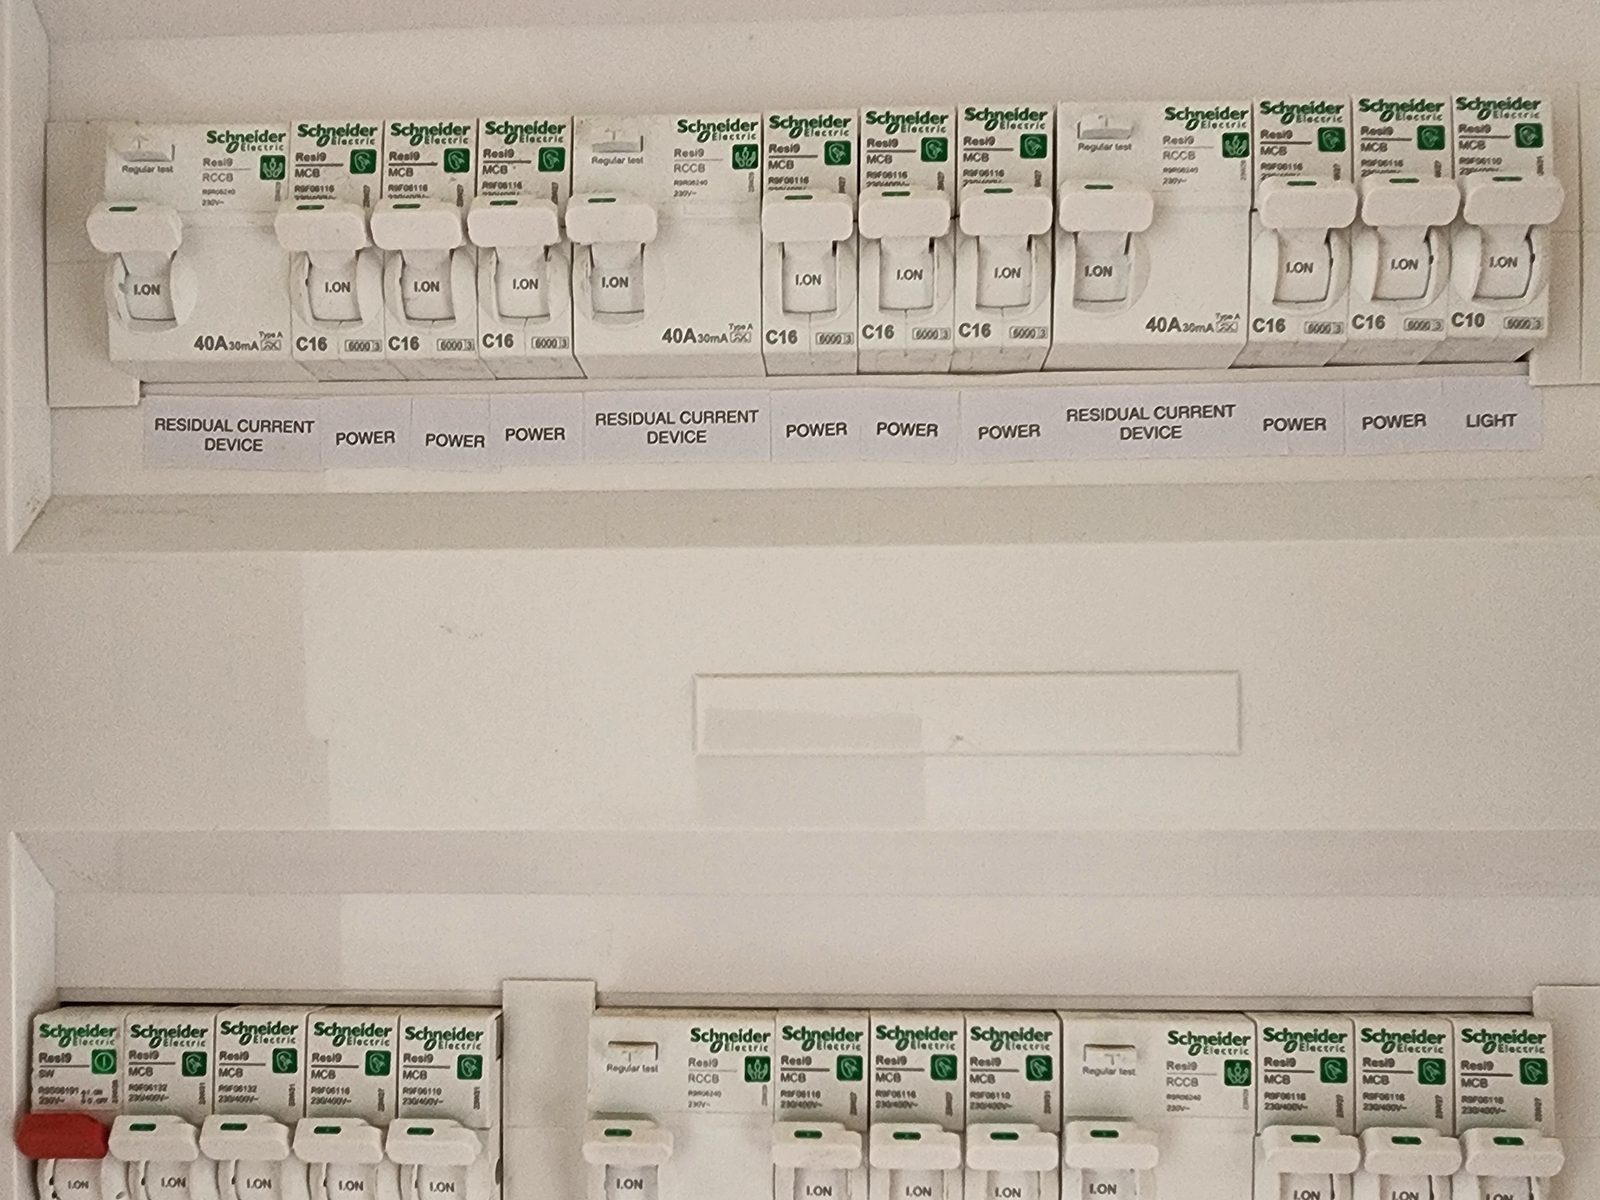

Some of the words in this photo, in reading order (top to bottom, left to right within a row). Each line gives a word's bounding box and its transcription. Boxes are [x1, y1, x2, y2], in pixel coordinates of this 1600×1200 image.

[1260, 100, 1344, 120] Schneider
[1359, 98, 1445, 118] Schneider
[1456, 96, 1541, 116] Schneider
[866, 110, 948, 130] Schneider
[964, 107, 1048, 127] Schneider
[1165, 106, 1249, 126] Schneider
[677, 119, 758, 139] Schneider
[769, 115, 851, 134] Schneider
[901, 123, 946, 133] Electric
[1200, 119, 1246, 129] Electric
[1458, 124, 1491, 134] Resi9
[298, 123, 377, 142] Schneider
[391, 122, 470, 142] Schneider
[485, 121, 565, 140] Schneider
[804, 127, 849, 137] Electric
[1260, 129, 1293, 140] Resi9
[1361, 126, 1393, 136] Resi9
[207, 129, 286, 149] Schneider
[331, 135, 375, 145] Electric
[424, 135, 468, 145] Electric
[519, 133, 563, 144] Electric
[867, 139, 899, 148] Resi9
[963, 136, 995, 146] Resi9
[1163, 135, 1194, 145] Resi9
[241, 143, 284, 151] Electric
[769, 144, 800, 154] Resi9
[1361, 143, 1387, 152] MCB
[1458, 140, 1486, 150] MCB
[483, 149, 514, 159] Resi9
[674, 149, 704, 158] Resi9
[1163, 150, 1196, 160] RCCB
[1260, 146, 1287, 156] MCB
[295, 152, 326, 162] Resi9
[389, 152, 420, 161] Resi9
[592, 156, 625, 165] Regular
[628, 156, 643, 164] test
[867, 155, 892, 164] MCB
[963, 153, 989, 162] MCB
[203, 158, 233, 167] Resi9
[769, 160, 794, 169] MCB
[295, 168, 320, 178] MCB
[388, 167, 414, 177] MCB
[482, 165, 508, 175] MCB
[674, 164, 705, 173] RCCB
[203, 173, 233, 182] RCCB
[1352, 314, 1386, 330] C16
[1452, 312, 1485, 328] C10
[959, 322, 991, 338] C16
[1253, 318, 1286, 333] C16
[862, 324, 894, 340] C16
[482, 333, 513, 348] C16
[766, 330, 797, 345] C16
[296, 337, 327, 351] C16
[388, 336, 419, 351] C16
[595, 411, 675, 426] RESIDUAL
[680, 409, 758, 424] CURRENT
[1066, 407, 1150, 422] RESIDUAL
[1154, 405, 1236, 419] CURRENT
[1263, 418, 1327, 432] POWER
[1362, 414, 1427, 430] POWER
[1466, 414, 1517, 428] LIGHT
[155, 418, 233, 433] RESIDUAL
[238, 419, 315, 435] CURRENT
[786, 422, 848, 437] POWER
[877, 422, 938, 437] POWER
[505, 427, 565, 442] POWER
[647, 430, 707, 444] DEVICE
[979, 424, 1040, 440] POWER
[1120, 426, 1182, 440] DEVICE
[336, 431, 395, 446] POWER
[426, 433, 485, 448] POWER
[205, 438, 263, 452] DEVICE
[39, 1023, 116, 1043] Schneider
[130, 1024, 208, 1044] Schneider
[221, 1021, 298, 1040] Schneider
[314, 1022, 392, 1041] Schneider
[405, 1026, 483, 1045] Schneider
[782, 1026, 863, 1045] Schneider
[876, 1025, 958, 1045] Schneider
[690, 1027, 771, 1048] Schneider
[970, 1026, 1053, 1046] Schneider
[1263, 1027, 1347, 1047] Schneider
[1361, 1028, 1446, 1048] Schneider
[1461, 1028, 1547, 1049] Schneider
[73, 1037, 115, 1046] Electric
[347, 1037, 390, 1046] Electric
[438, 1041, 481, 1050] Electric
[817, 1041, 861, 1050] Electric
[1168, 1031, 1251, 1052] Schneider
[1300, 1043, 1345, 1053] Electric
[39, 1053, 72, 1063] Resi9
[129, 1050, 159, 1060] Resi9
[219, 1051, 249, 1060] Resi9
[311, 1053, 342, 1063] Resi9
[403, 1054, 433, 1063] Resi9
[688, 1058, 718, 1067] Resi9
[781, 1056, 812, 1065] Resi9
[876, 1056, 907, 1065] Resi9
[970, 1057, 1001, 1066] Resi9
[1264, 1057, 1296, 1067] Resi9
[1362, 1058, 1395, 1067] Resi9
[1167, 1061, 1197, 1071] Resi9
[1461, 1061, 1494, 1071] Resi9
[129, 1067, 153, 1076] MCB
[219, 1068, 243, 1077] MCB
[311, 1070, 336, 1079] MCB
[403, 1070, 427, 1079] MCB
[688, 1075, 719, 1083] RCCB
[781, 1073, 806, 1083] MCB
[875, 1073, 901, 1083] MCB
[970, 1074, 995, 1084] MCB
[1167, 1077, 1198, 1087] RCCB
[1264, 1075, 1290, 1084] MCB
[1362, 1075, 1389, 1085] MCB
[1461, 1079, 1488, 1088] MCB
